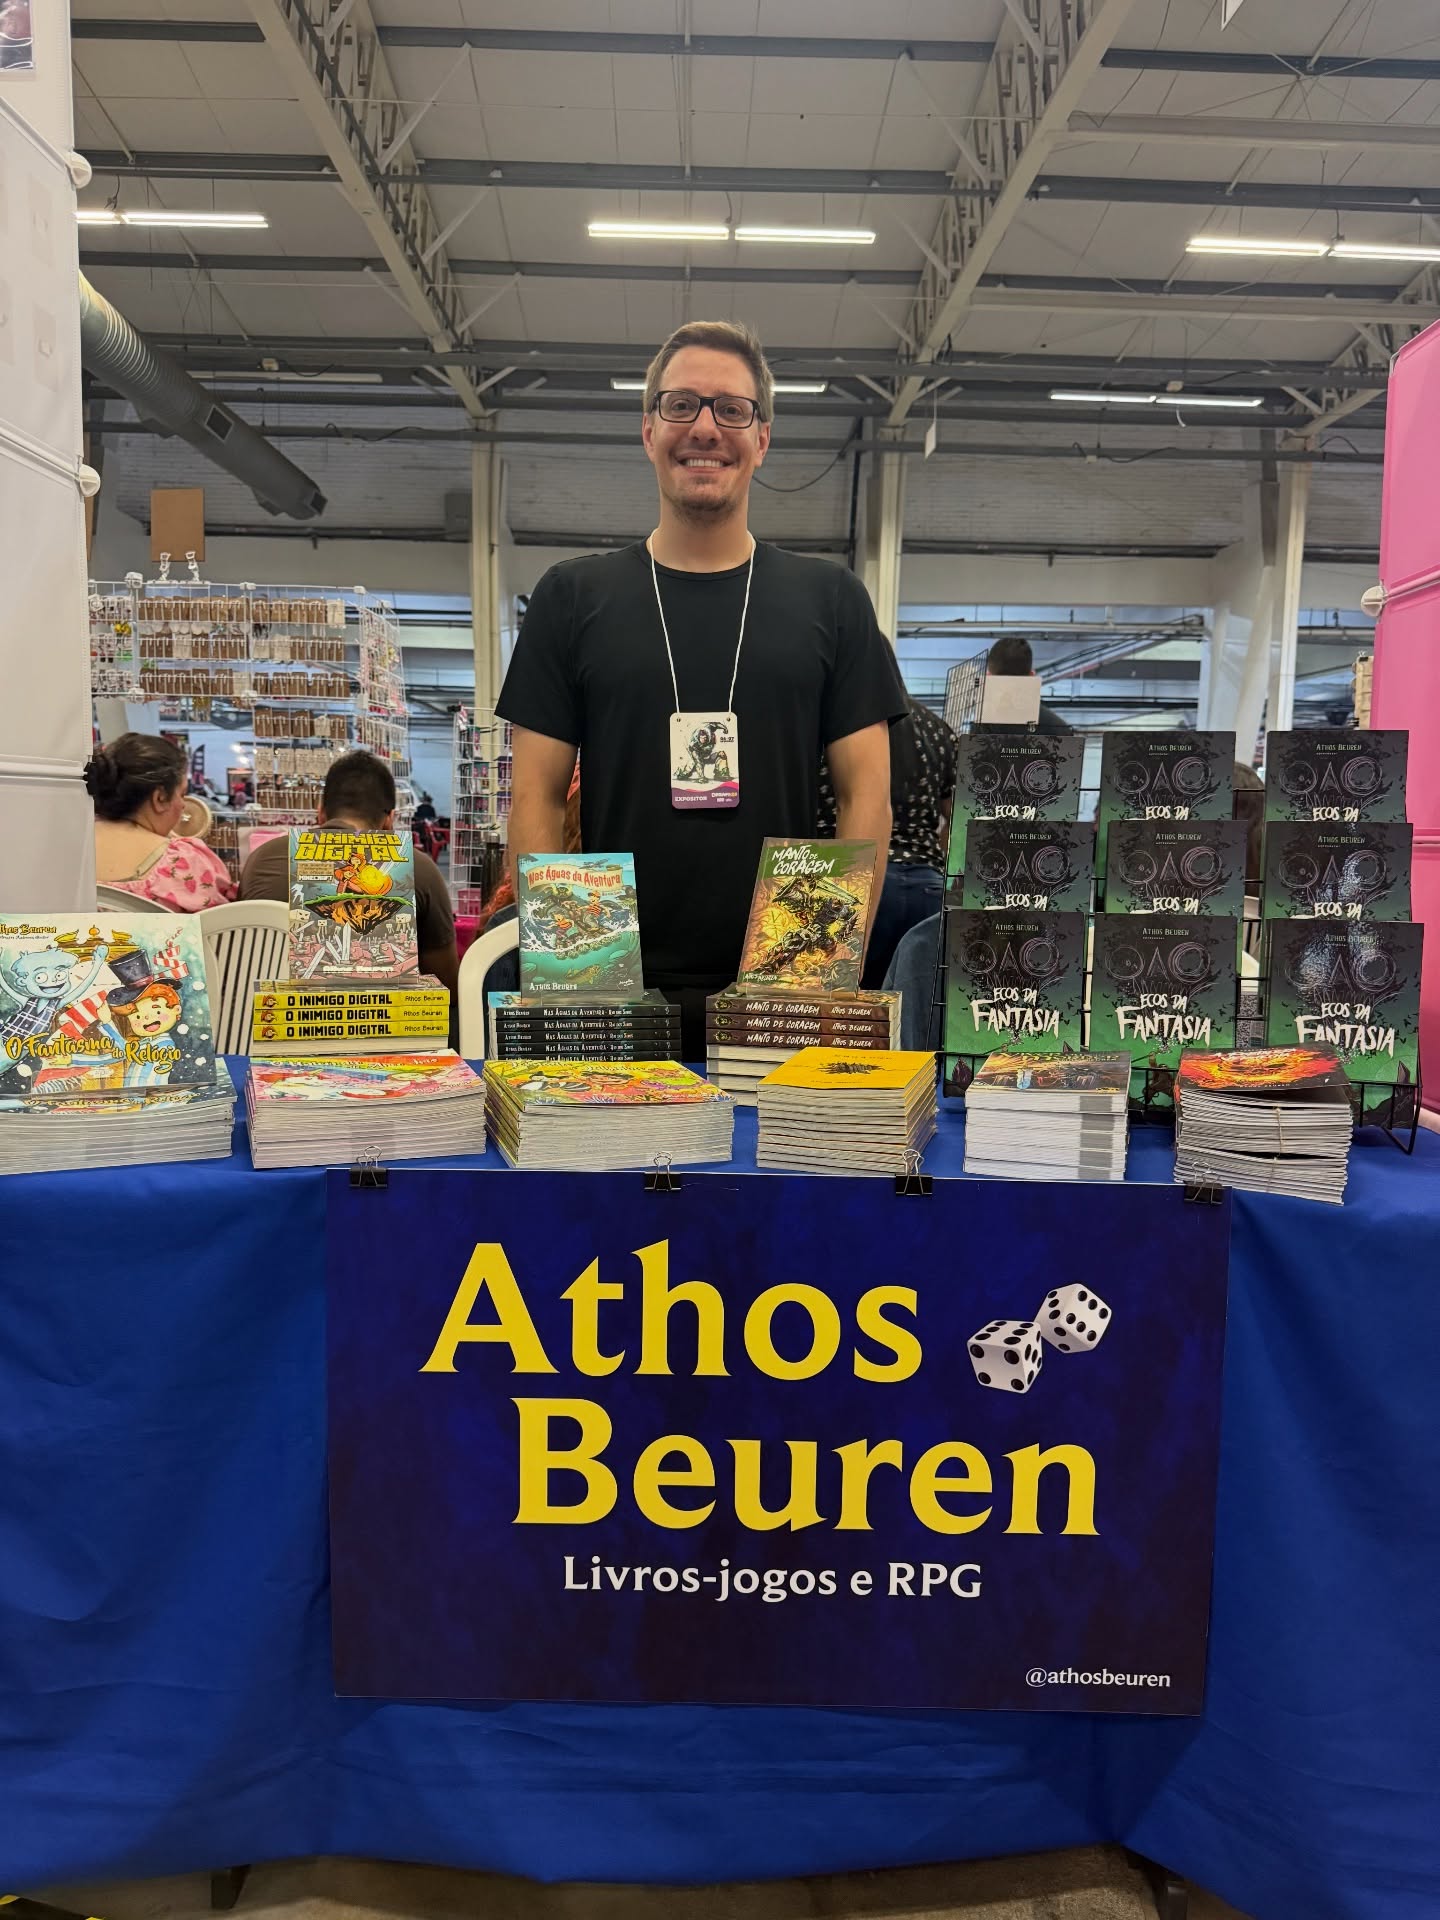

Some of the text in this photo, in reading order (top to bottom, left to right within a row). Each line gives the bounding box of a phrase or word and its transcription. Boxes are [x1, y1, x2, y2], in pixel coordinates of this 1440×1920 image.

[995, 805, 1035, 821] ECOS DA
[1146, 806, 1189, 821] ECOS DA
[1313, 807, 1360, 822] ECOS DA
[298, 832, 402, 846] O INIMIGO
[294, 843, 409, 862] DIGITAL
[772, 844, 812, 861] MANTO
[772, 859, 835, 875] CORAGEM
[546, 866, 571, 880] Águas
[572, 871, 582, 881] da
[584, 872, 621, 888] Aventura
[1005, 894, 1048, 911] ECOS DA
[1153, 897, 1199, 915] ECOS DA
[1314, 901, 1363, 920] ECOS DA
[287, 994, 392, 1006] O INIMIGO DIGITAL
[993, 987, 1037, 1005] ECOS DA
[1140, 993, 1189, 1013] ECOS DA
[285, 1009, 391, 1021] O INIMIGO DIGITAL
[746, 1002, 820, 1015] MANTO DE CORAGEM
[1321, 1002, 1371, 1024] ECOS DA
[747, 1018, 821, 1031] MANTO DE CORAGEM
[970, 999, 1060, 1040] FANTASIA
[1115, 1005, 1211, 1047] FANTASIA
[286, 1024, 391, 1037] O INIMIGO DIGITAL
[1294, 1015, 1396, 1058] FANTASIA
[747, 1034, 821, 1046] MANTO DE CORAGEM
[6, 1032, 181, 1075] O Fantasma do Relógio
[418, 1238, 922, 1383] Athos
[510, 1397, 1100, 1536] Beuren
[563, 1555, 982, 1603] Livros-jogos e RPG
[1025, 1667, 1171, 1688] @athosbeuren
